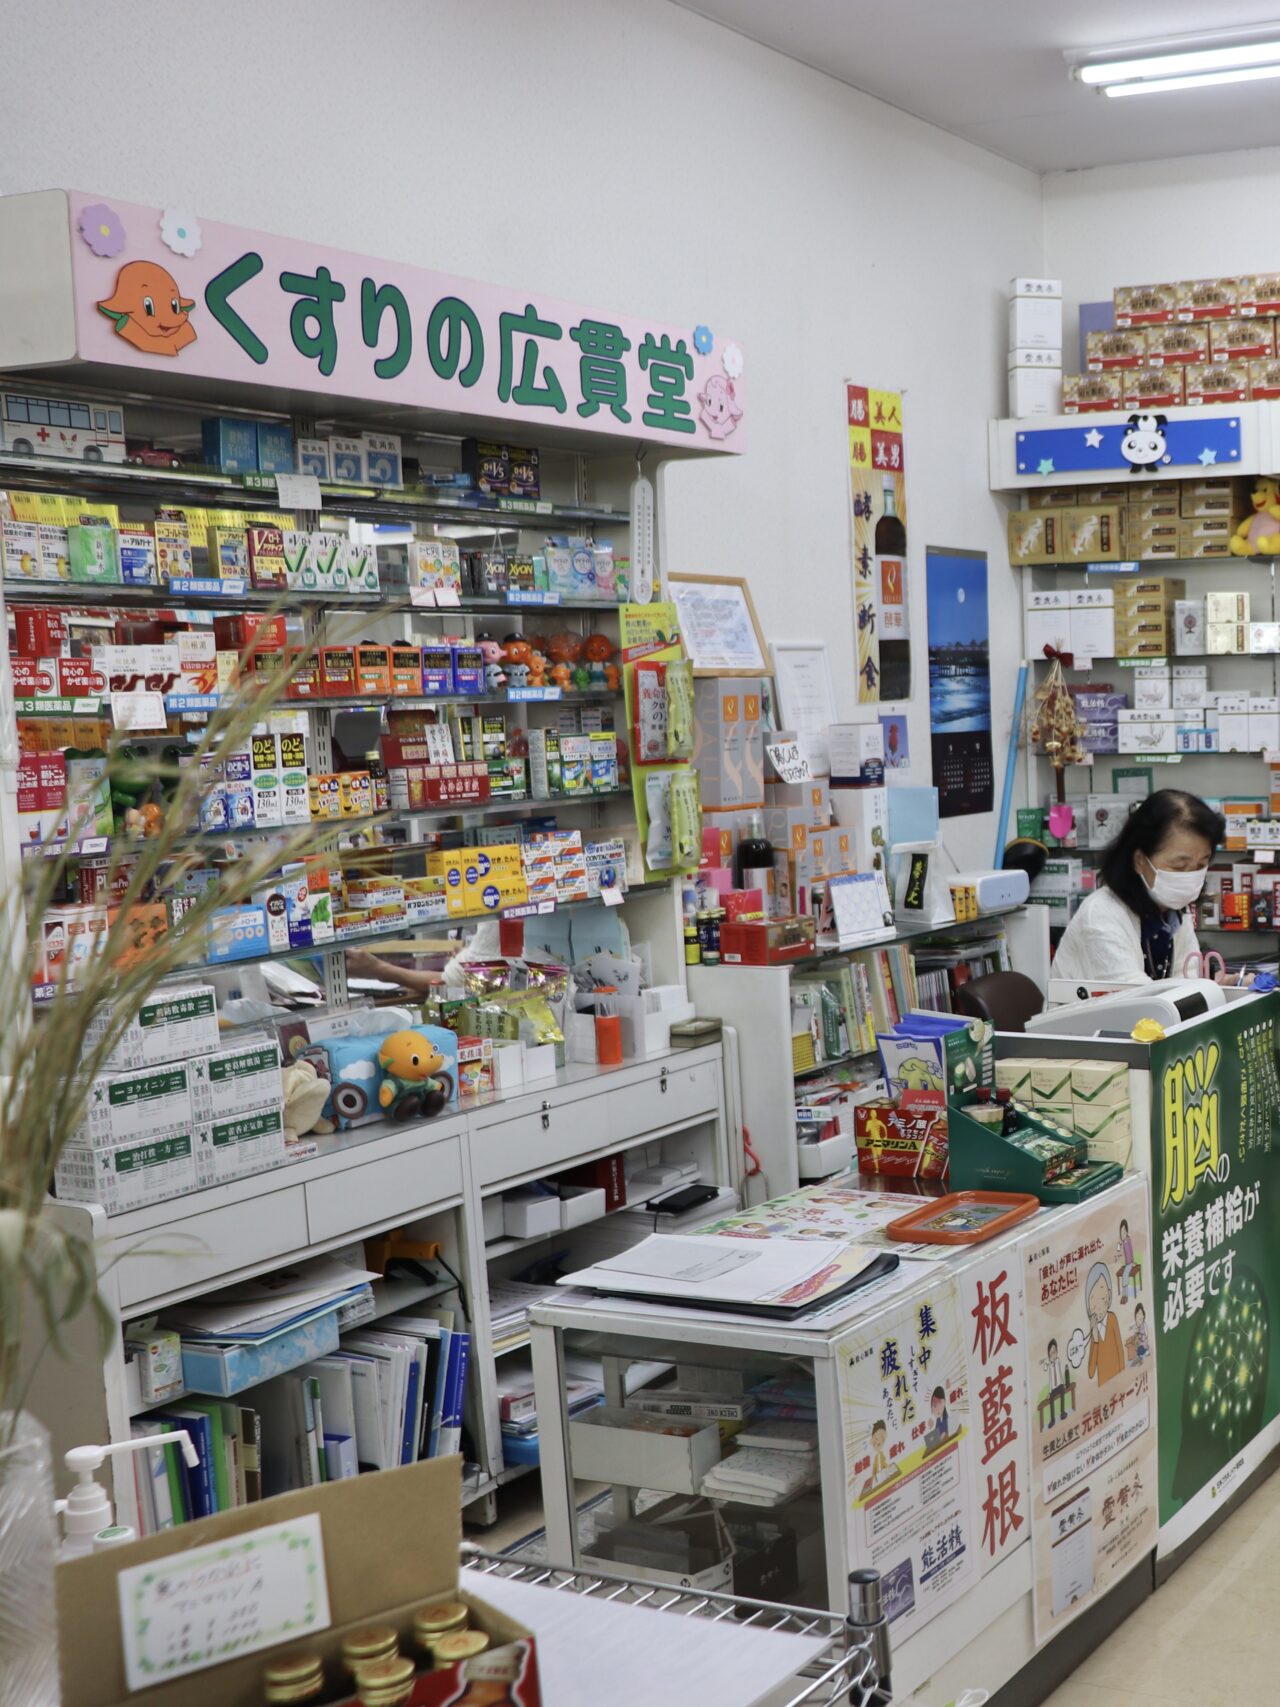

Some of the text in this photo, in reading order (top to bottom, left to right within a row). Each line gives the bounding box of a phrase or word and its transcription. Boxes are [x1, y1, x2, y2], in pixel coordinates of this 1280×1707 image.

[204, 251, 697, 436] くすりの広貫堂
[853, 493, 880, 692] 酵素断食
[126, 1078, 166, 1096] ヨクイニン
[887, 1117, 928, 1130] アミノ酸
[864, 1139, 919, 1150] アニマリンA
[1161, 1180, 1261, 1280] 栄養補給が
[1162, 1248, 1237, 1334] 必要です
[918, 1304, 937, 1372] 集中
[880, 1341, 915, 1424] 疲れた
[971, 1269, 1025, 1557] 板藍根
[911, 1421, 926, 1441] 仕事
[921, 1524, 964, 1573] 能活精
